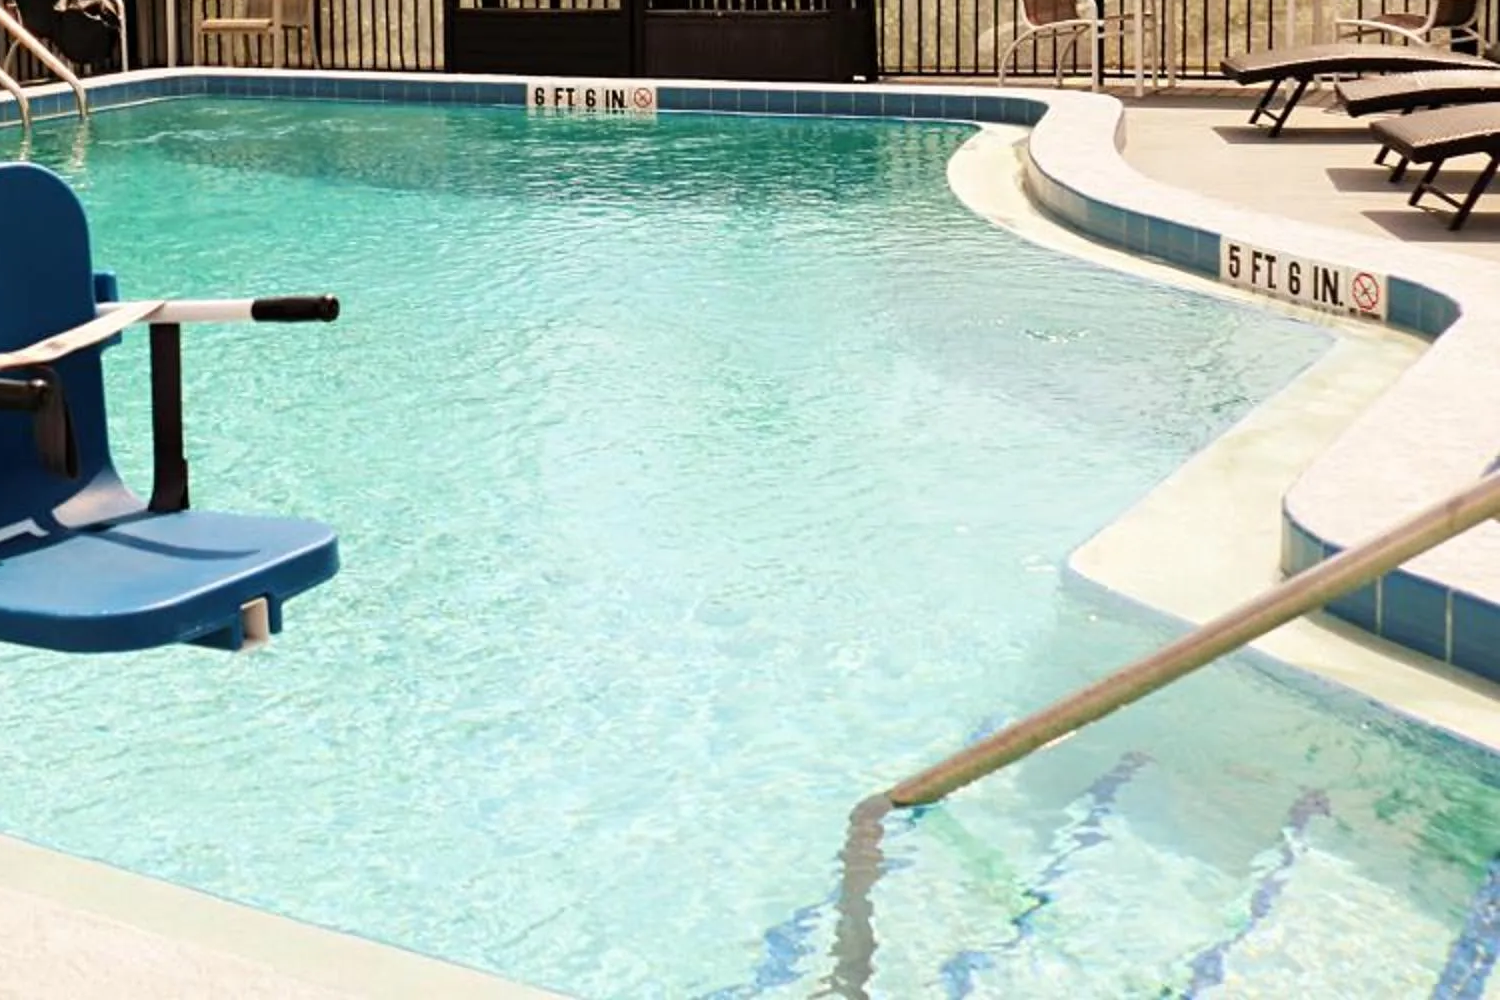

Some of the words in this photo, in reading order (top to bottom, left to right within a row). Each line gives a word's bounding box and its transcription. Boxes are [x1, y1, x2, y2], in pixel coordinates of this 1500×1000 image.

[534, 87, 546, 107] 6
[585, 88, 597, 108] 6
[1228, 243, 1242, 279] 5
[1287, 261, 1301, 296] 6
